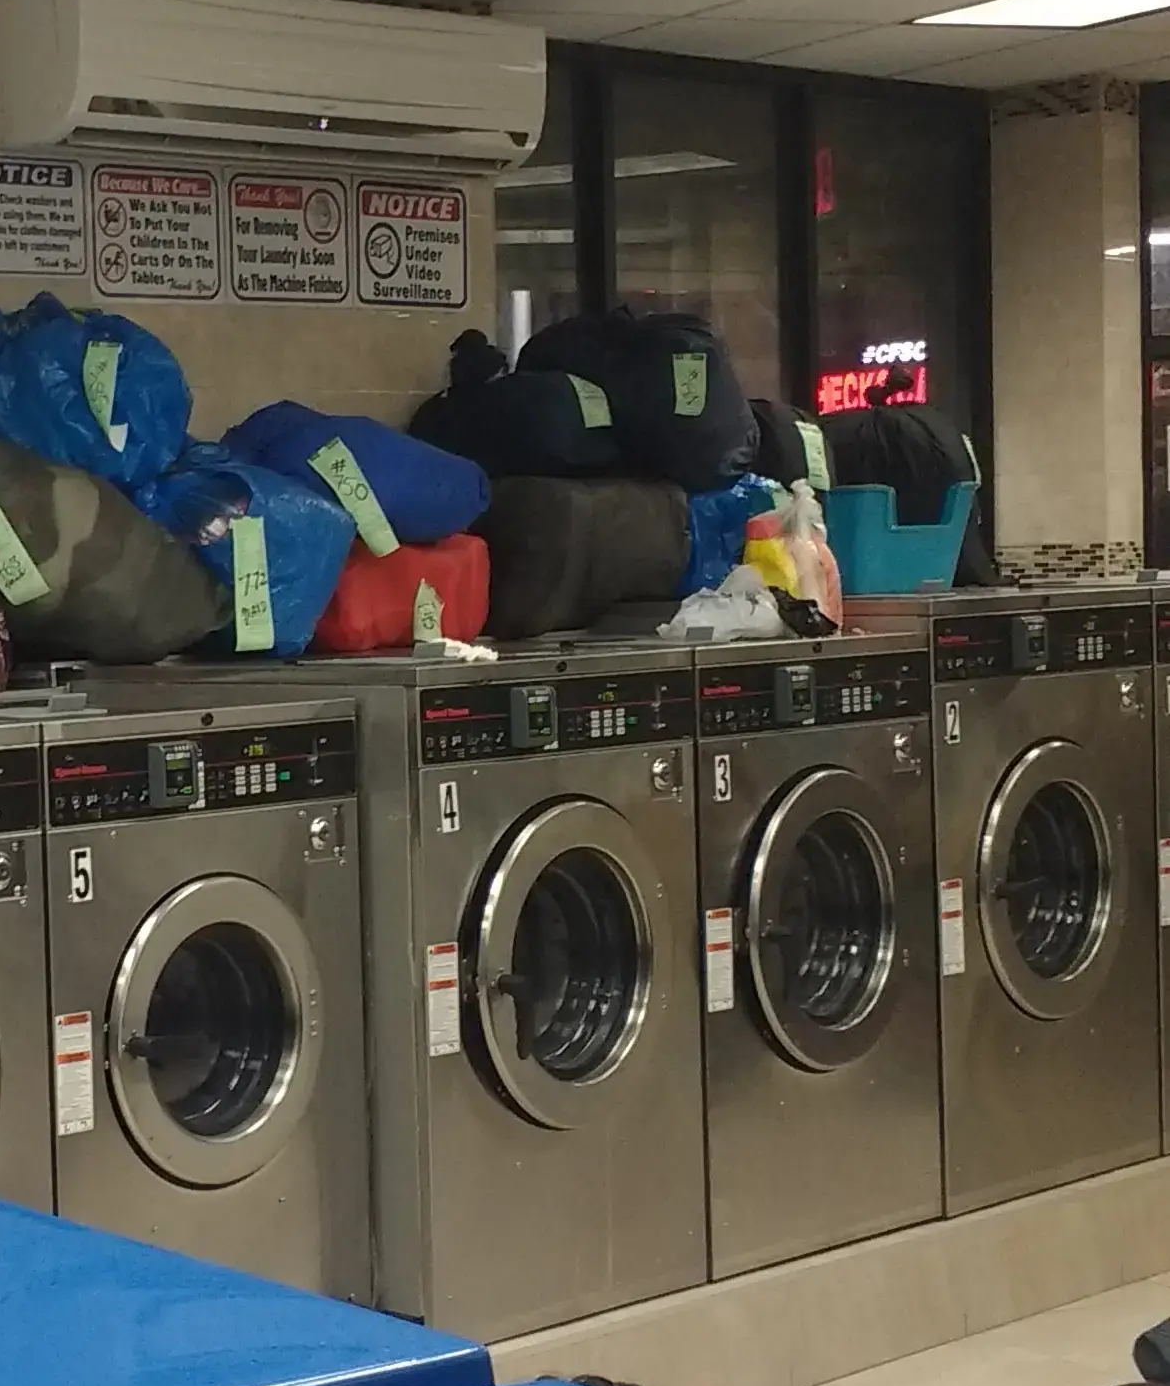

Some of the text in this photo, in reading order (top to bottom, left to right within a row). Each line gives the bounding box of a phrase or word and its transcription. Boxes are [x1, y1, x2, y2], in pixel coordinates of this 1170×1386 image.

[152, 177, 169, 192] We
[129, 199, 212, 215] We Ask You Not
[370, 193, 455, 219] NOTICE
[129, 217, 190, 232] To Put Your
[236, 216, 250, 234] For
[130, 235, 175, 249] Children
[191, 238, 209, 251] The
[405, 225, 460, 244] Premises
[130, 253, 214, 269] Carts Or On The
[300, 247, 310, 265] As
[405, 245, 443, 262] Under
[131, 271, 165, 285] Tables
[405, 264, 441, 281] Video
[237, 273, 249, 291] As
[251, 273, 267, 292] The
[269, 274, 306, 293] Machine
[373, 281, 452, 300] Surveillance
[333, 474, 369, 501] 750
[947, 705, 960, 741] 2
[718, 758, 730, 798] 3
[442, 785, 456, 829] 4
[72, 852, 90, 900] 5
